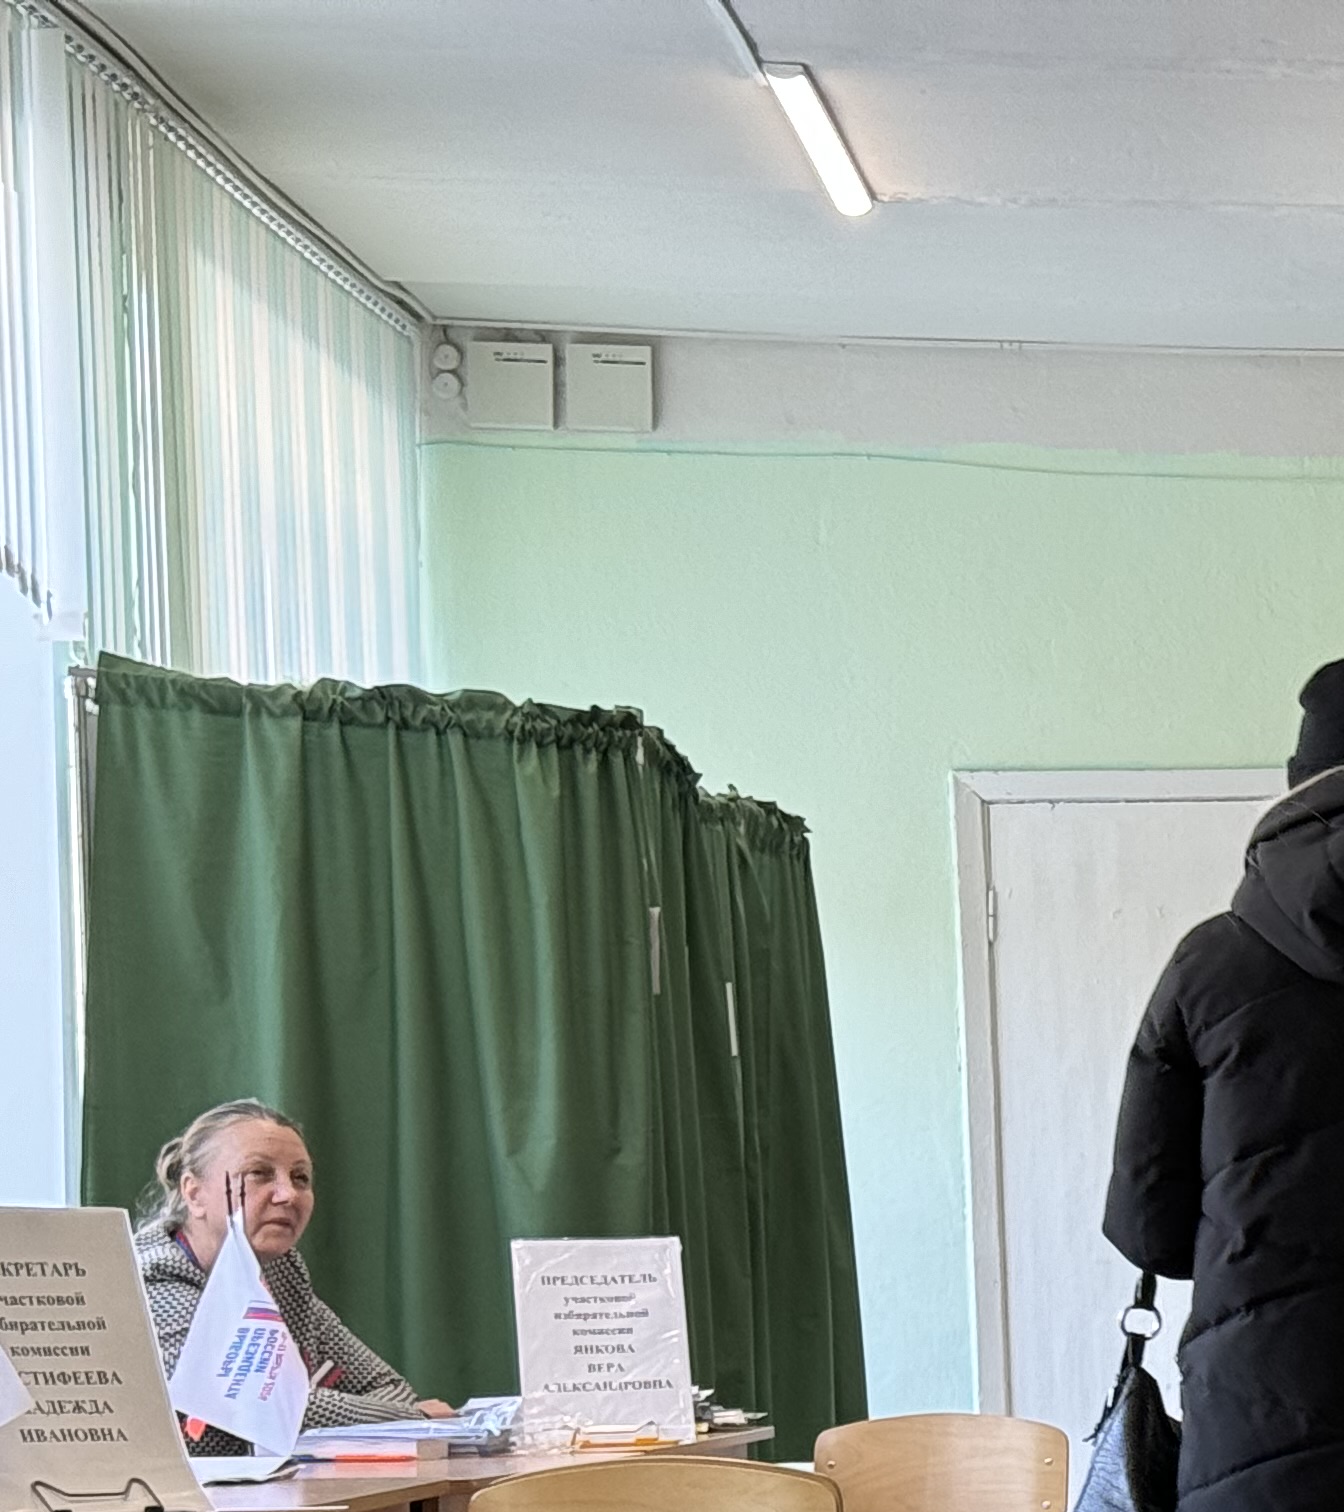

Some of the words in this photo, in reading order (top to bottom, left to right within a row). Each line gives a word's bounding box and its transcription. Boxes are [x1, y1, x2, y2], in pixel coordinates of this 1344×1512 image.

[0, 1261, 87, 1278] КРЕТАРЬ
[541, 1273, 658, 1287] ПРЕДСЕДАТЕЛЬ
[0, 1292, 87, 1307] частковой
[0, 1316, 107, 1336] бирательной
[10, 1345, 91, 1357] комиссии
[573, 1343, 636, 1355] ЯНКОВА
[587, 1362, 625, 1373] ВЕРА
[18, 1370, 123, 1386] СТИФЕЕВА
[25, 1399, 115, 1416] АДЕЖДА
[19, 1427, 129, 1443] ИВАНОВНА
